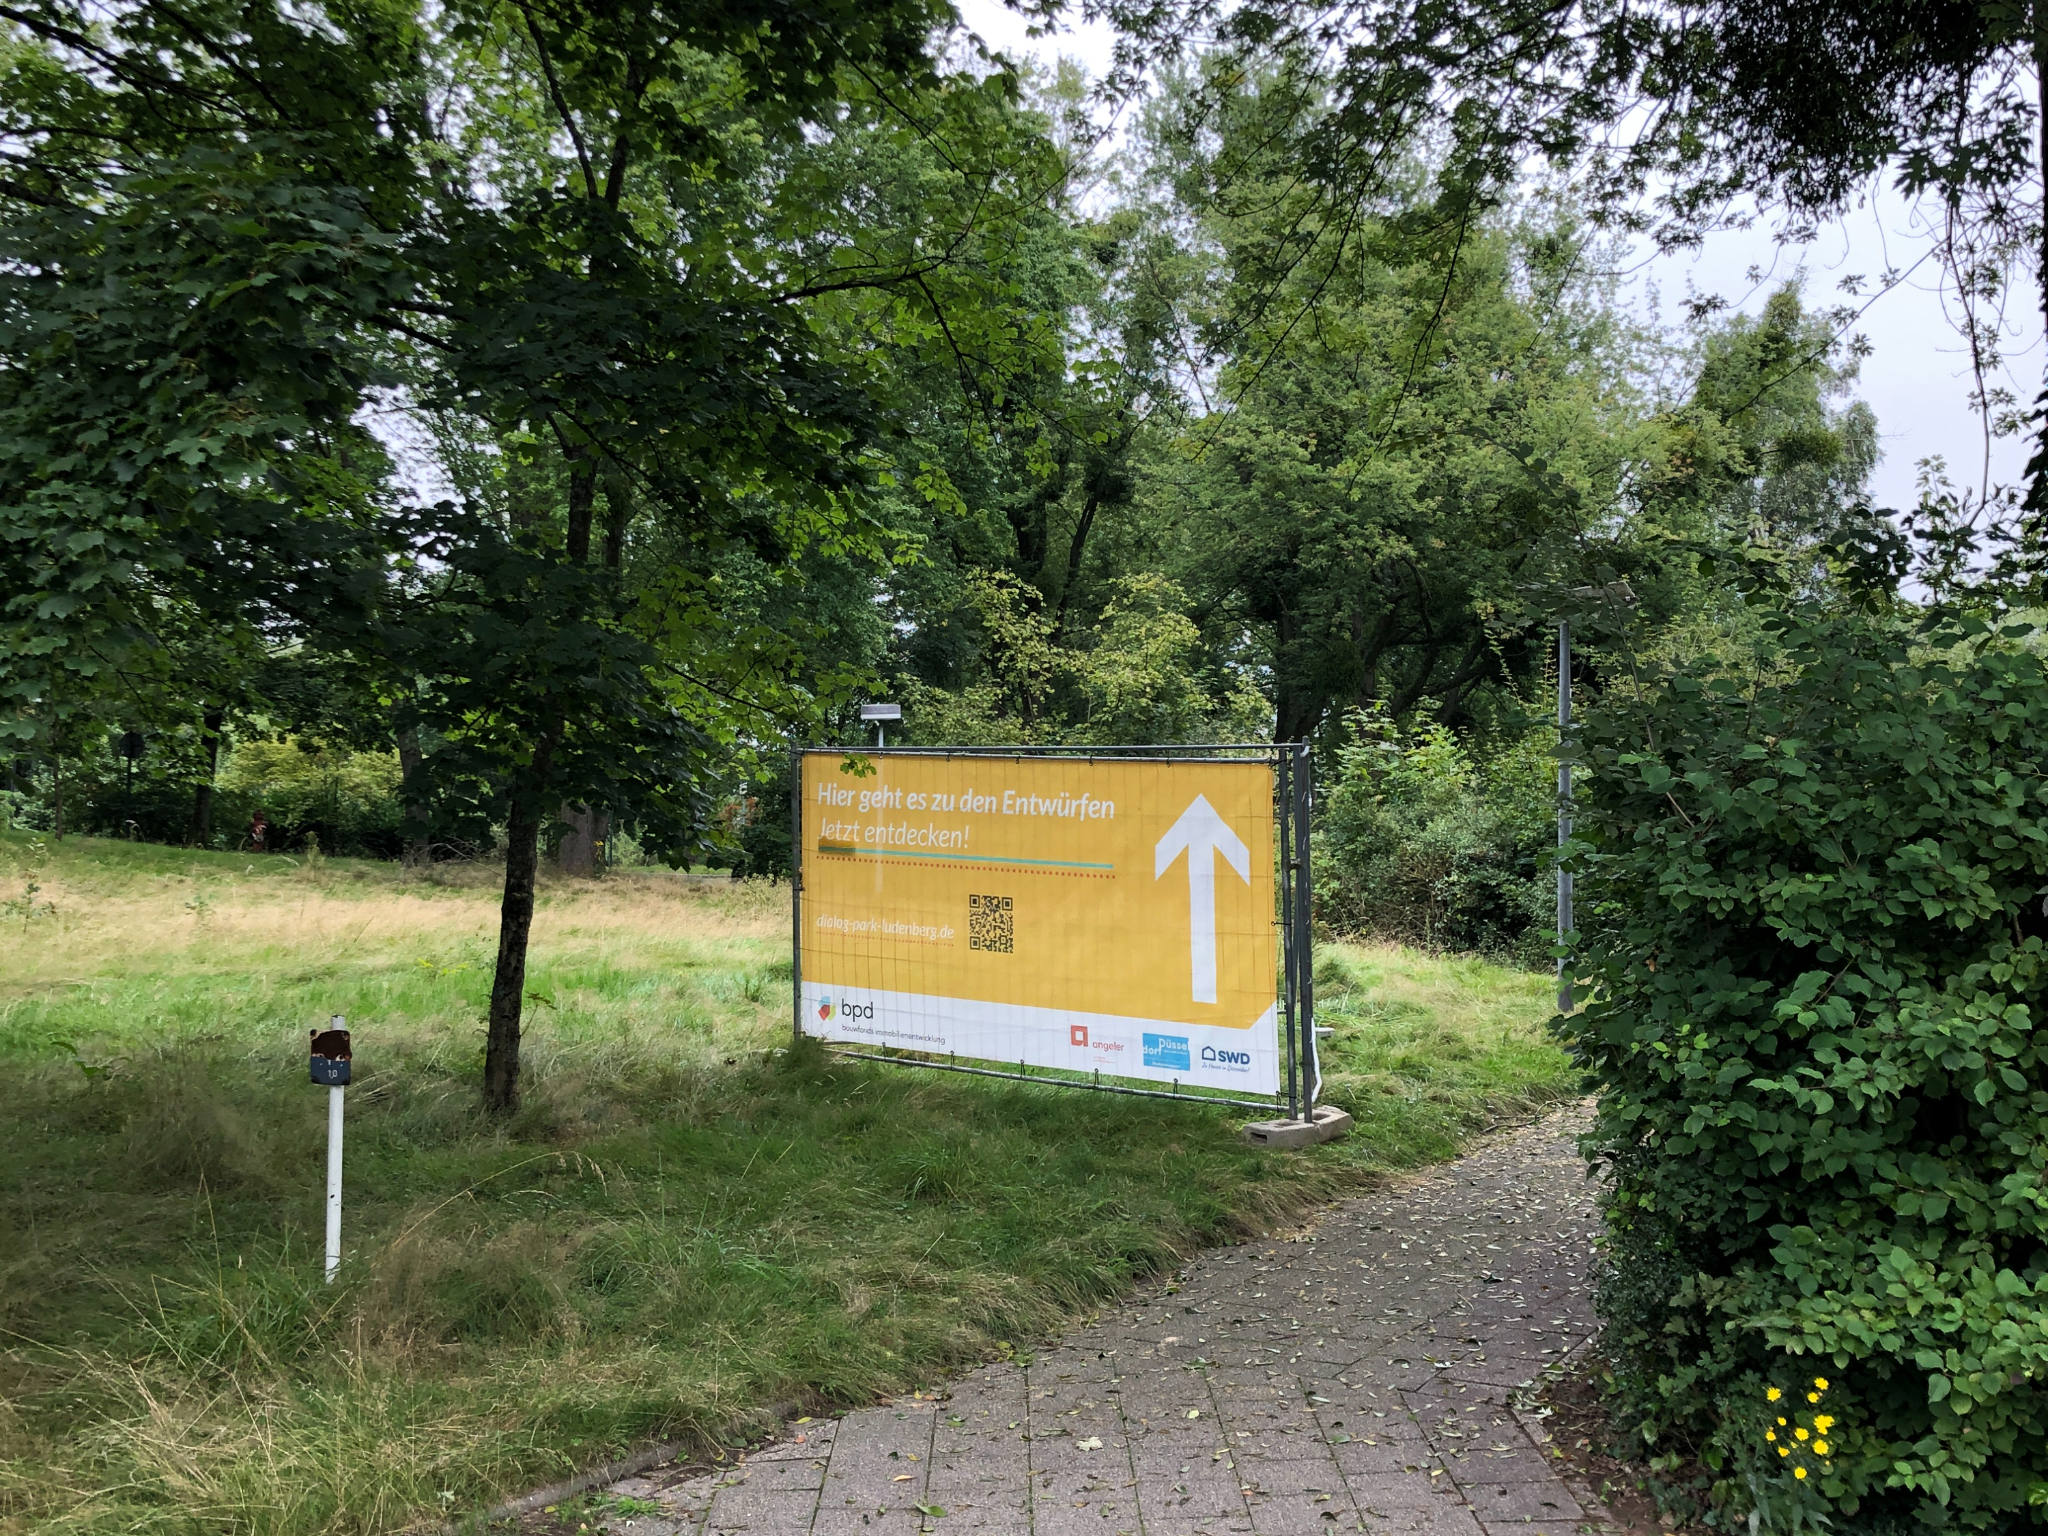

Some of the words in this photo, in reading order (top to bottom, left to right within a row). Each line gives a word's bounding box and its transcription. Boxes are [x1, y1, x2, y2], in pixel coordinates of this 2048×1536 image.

[817, 782, 856, 807] Hier
[859, 785, 903, 813] geht
[906, 791, 926, 811] es
[930, 792, 955, 813] zu
[959, 787, 997, 813] den
[1002, 790, 1115, 822] Entwürfen
[819, 817, 860, 843] Jetzt
[864, 821, 970, 848] entdecken!
[816, 912, 955, 940] dialog-park-ludenberg.de
[841, 998, 874, 1022] bpd
[1092, 1041, 1125, 1052] angeler
[1217, 1050, 1251, 1065] SWD
